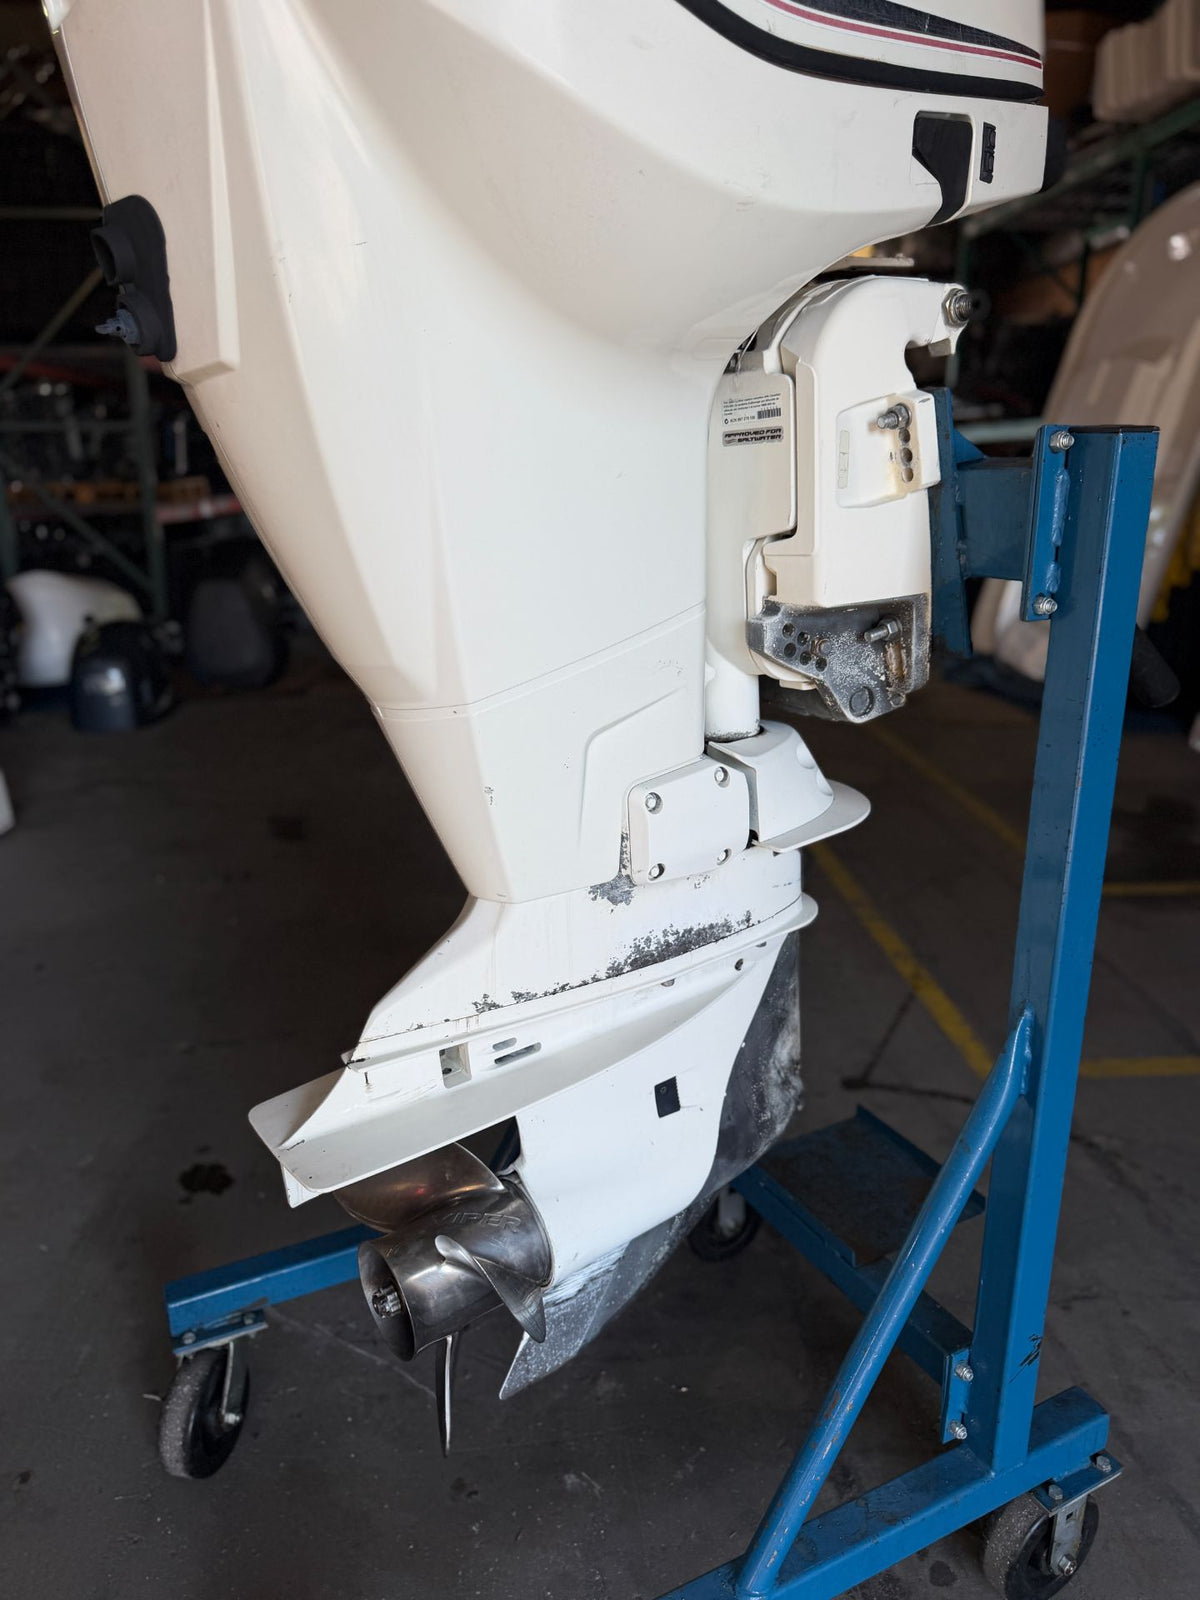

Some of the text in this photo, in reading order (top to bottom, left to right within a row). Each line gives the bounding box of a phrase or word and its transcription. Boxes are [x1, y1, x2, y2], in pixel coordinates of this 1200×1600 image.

[724, 430, 765, 438] APPROVED
[737, 434, 782, 442] SALTWATER
[434, 1212, 522, 1233] VIPER
